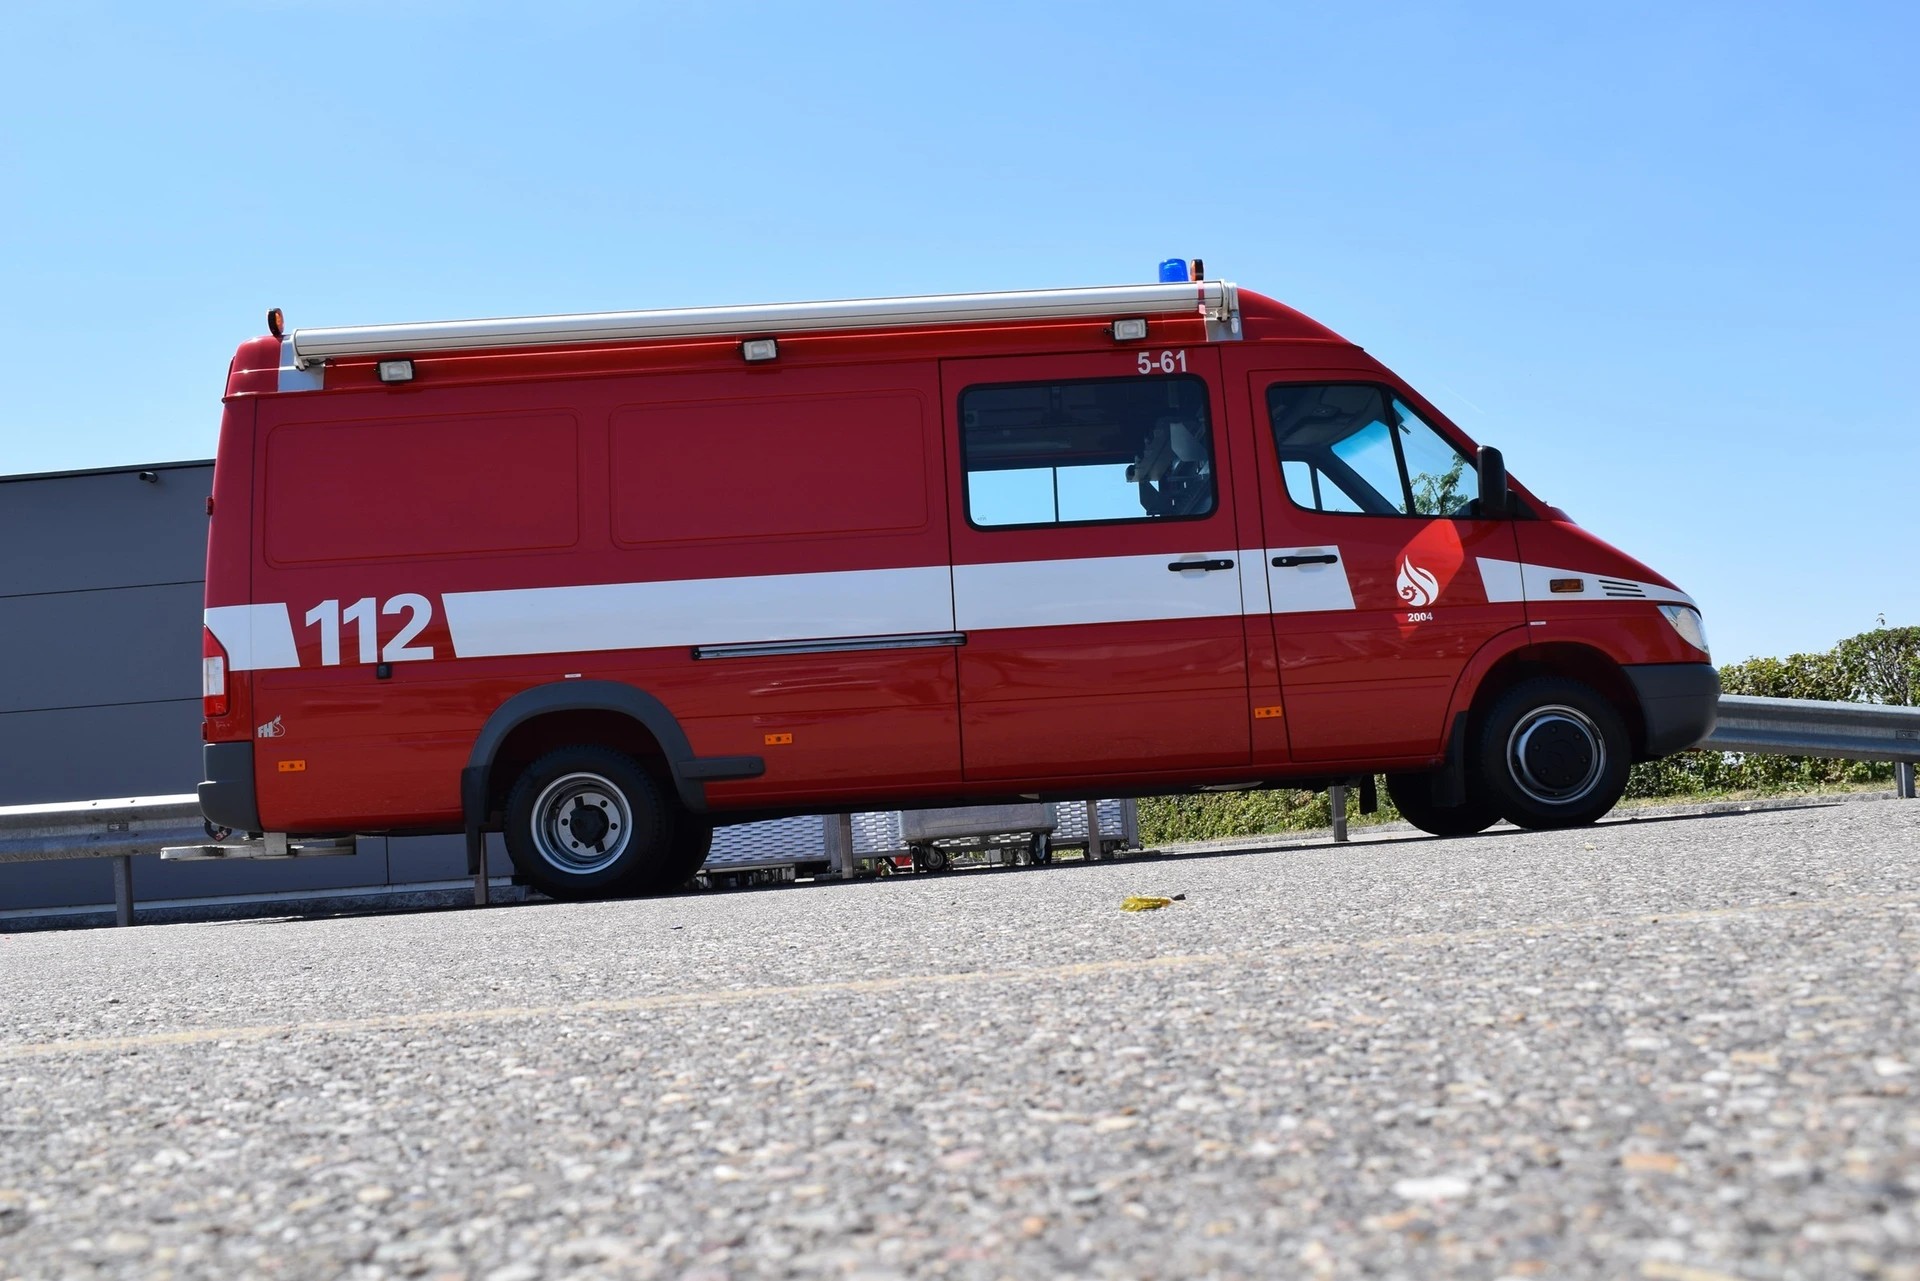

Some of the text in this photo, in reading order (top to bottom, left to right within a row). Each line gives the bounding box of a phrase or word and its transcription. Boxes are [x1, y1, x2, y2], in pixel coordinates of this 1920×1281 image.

[1137, 350, 1187, 375] 5-61
[305, 592, 434, 666] 112
[1407, 612, 1433, 622] 2004
